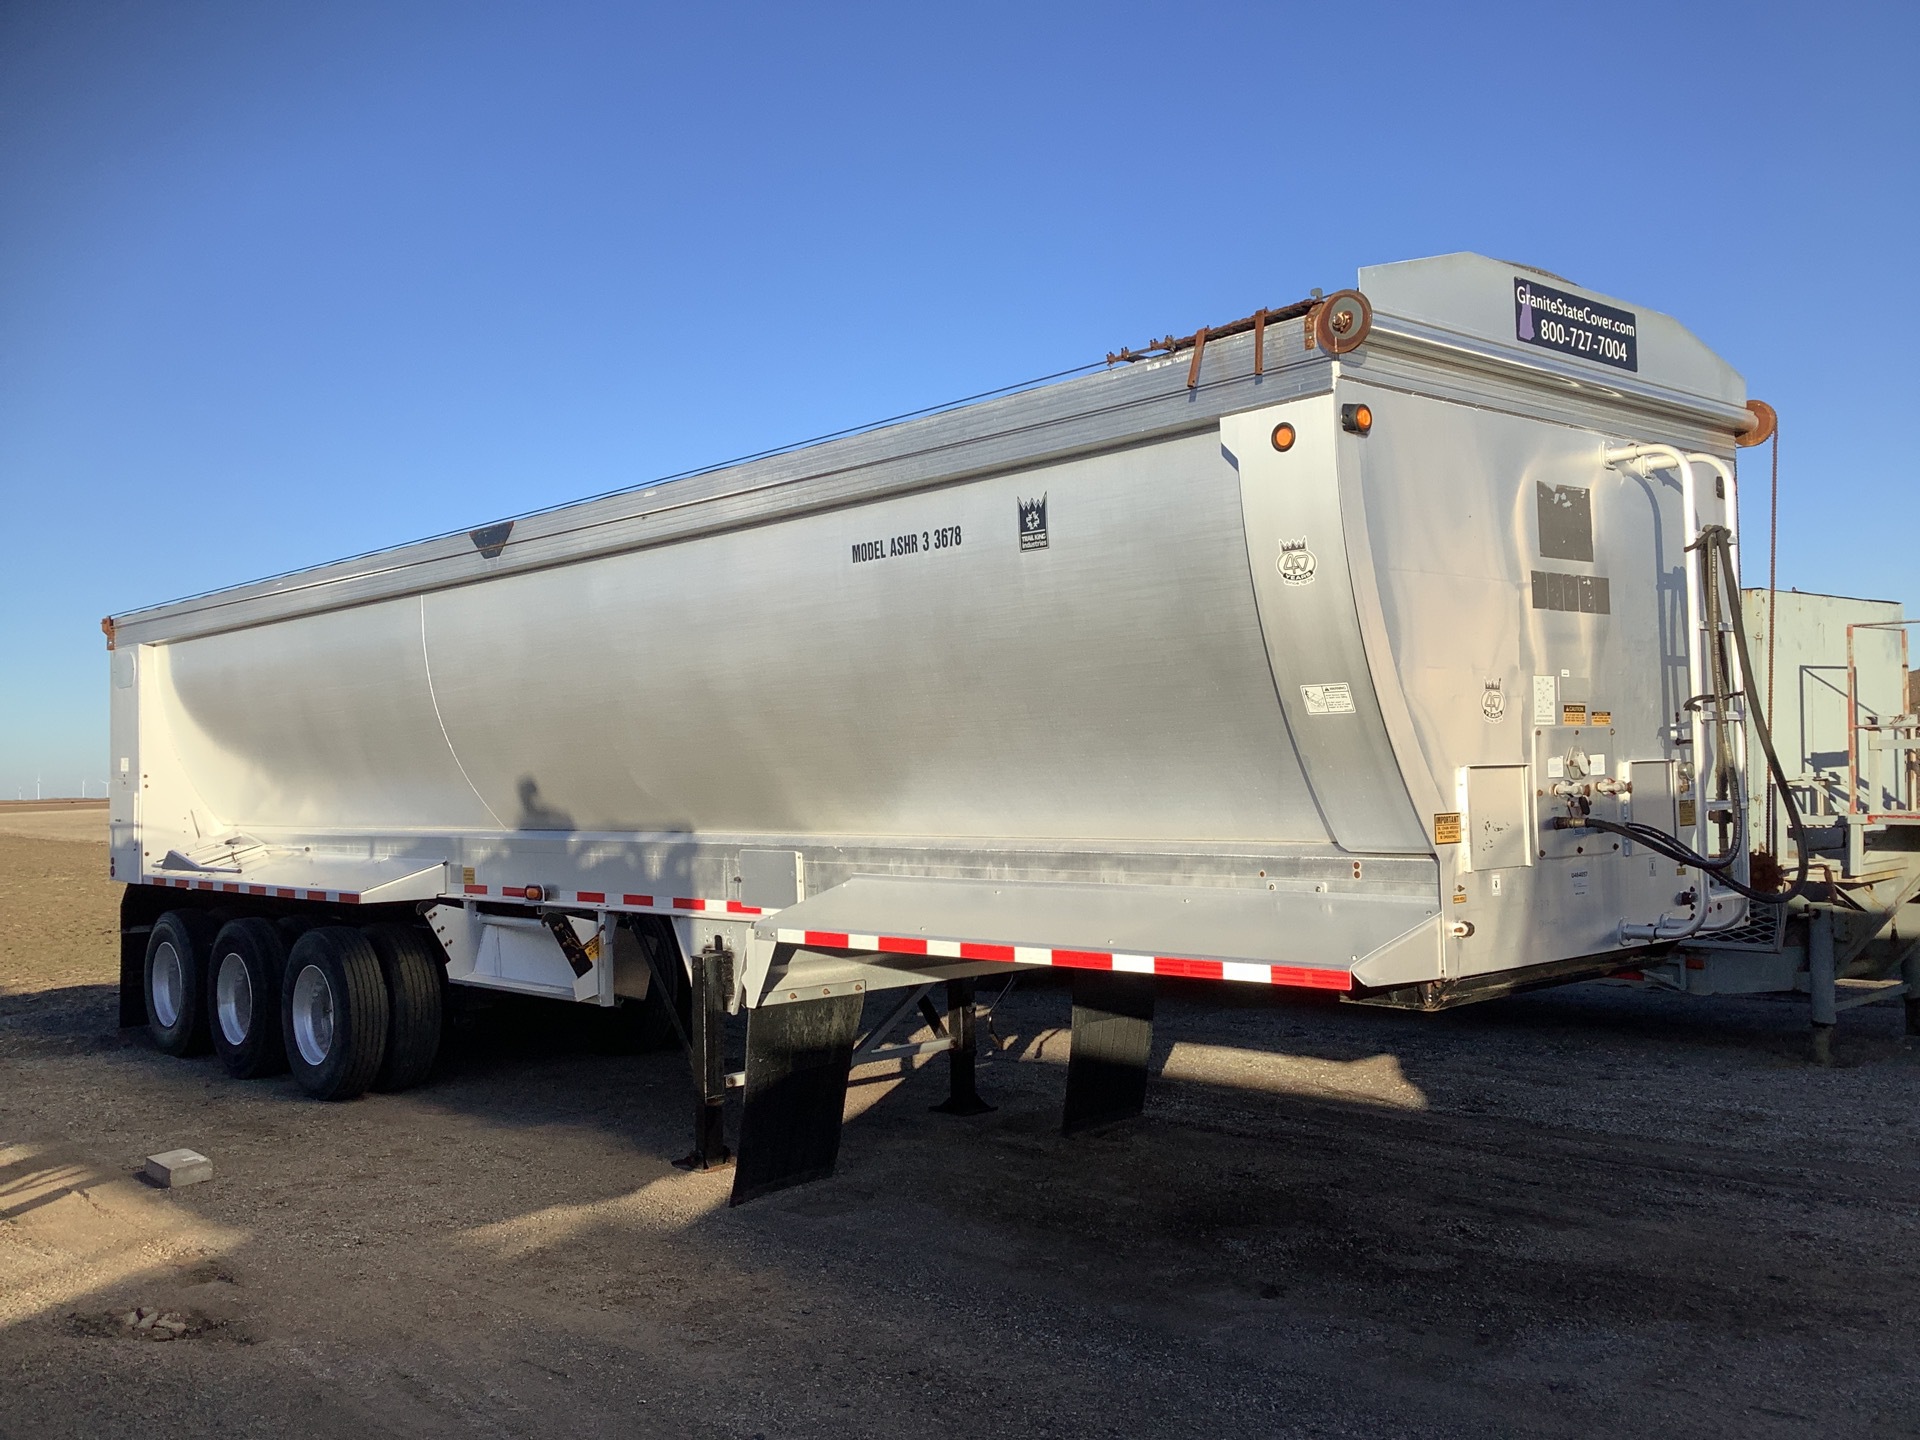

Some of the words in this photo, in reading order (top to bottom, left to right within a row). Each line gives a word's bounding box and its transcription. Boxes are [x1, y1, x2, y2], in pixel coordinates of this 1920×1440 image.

[1516, 286, 1635, 337] GraniteStateCover.com
[1540, 319, 1628, 362] 800-727-7004
[852, 540, 886, 563] MODEL
[890, 533, 918, 558] ASHR
[922, 531, 930, 552] 3
[934, 525, 962, 549] 3678
[1286, 571, 1312, 581] YEARS
[1436, 815, 1459, 824] IMPORTANT
